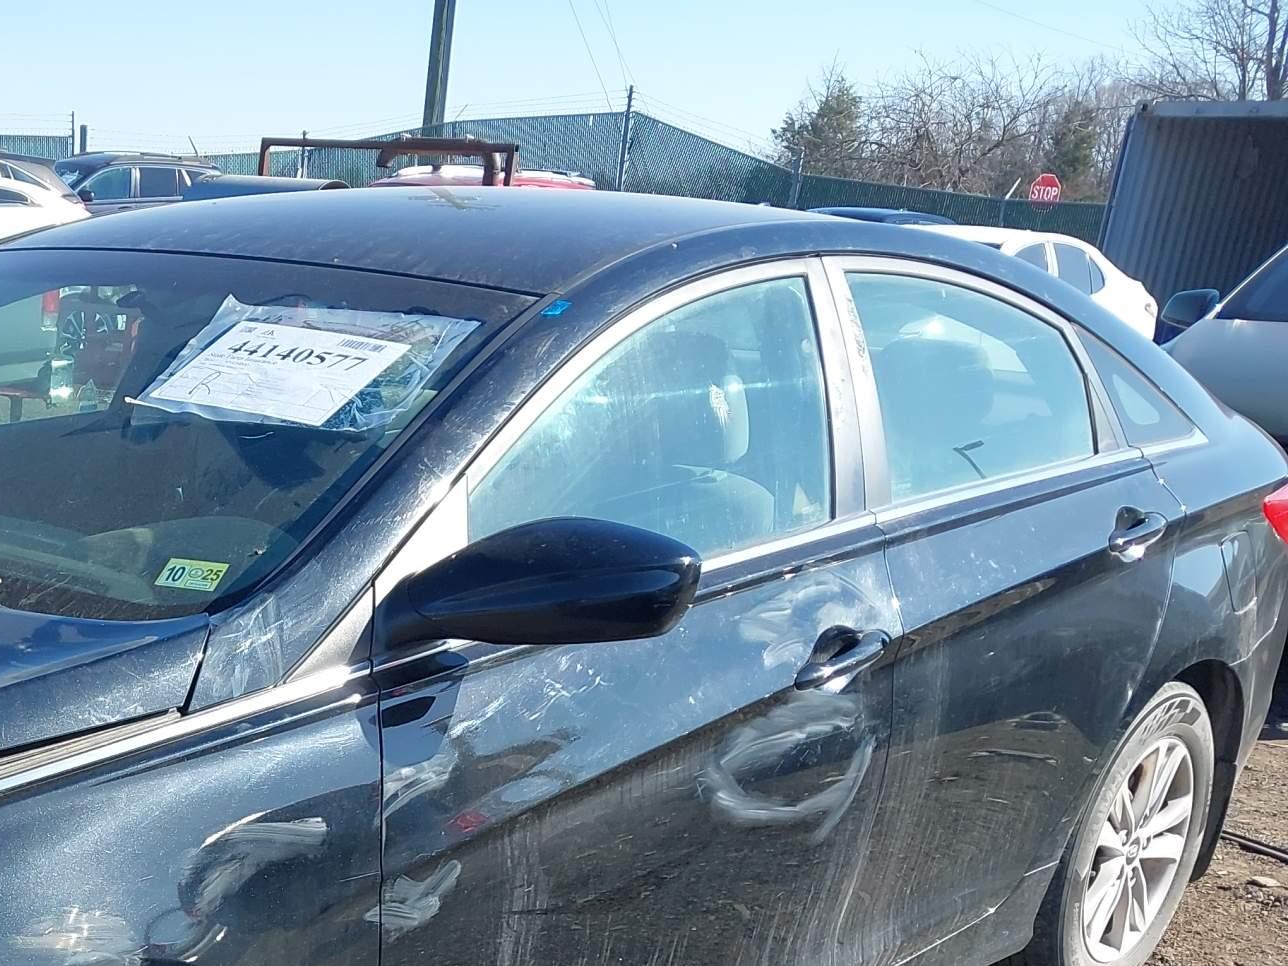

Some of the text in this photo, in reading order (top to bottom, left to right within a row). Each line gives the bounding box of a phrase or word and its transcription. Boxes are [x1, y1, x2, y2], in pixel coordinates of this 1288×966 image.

[1031, 185, 1058, 200] STOP
[228, 340, 367, 370] 44140577
[166, 567, 223, 582] 10 25
